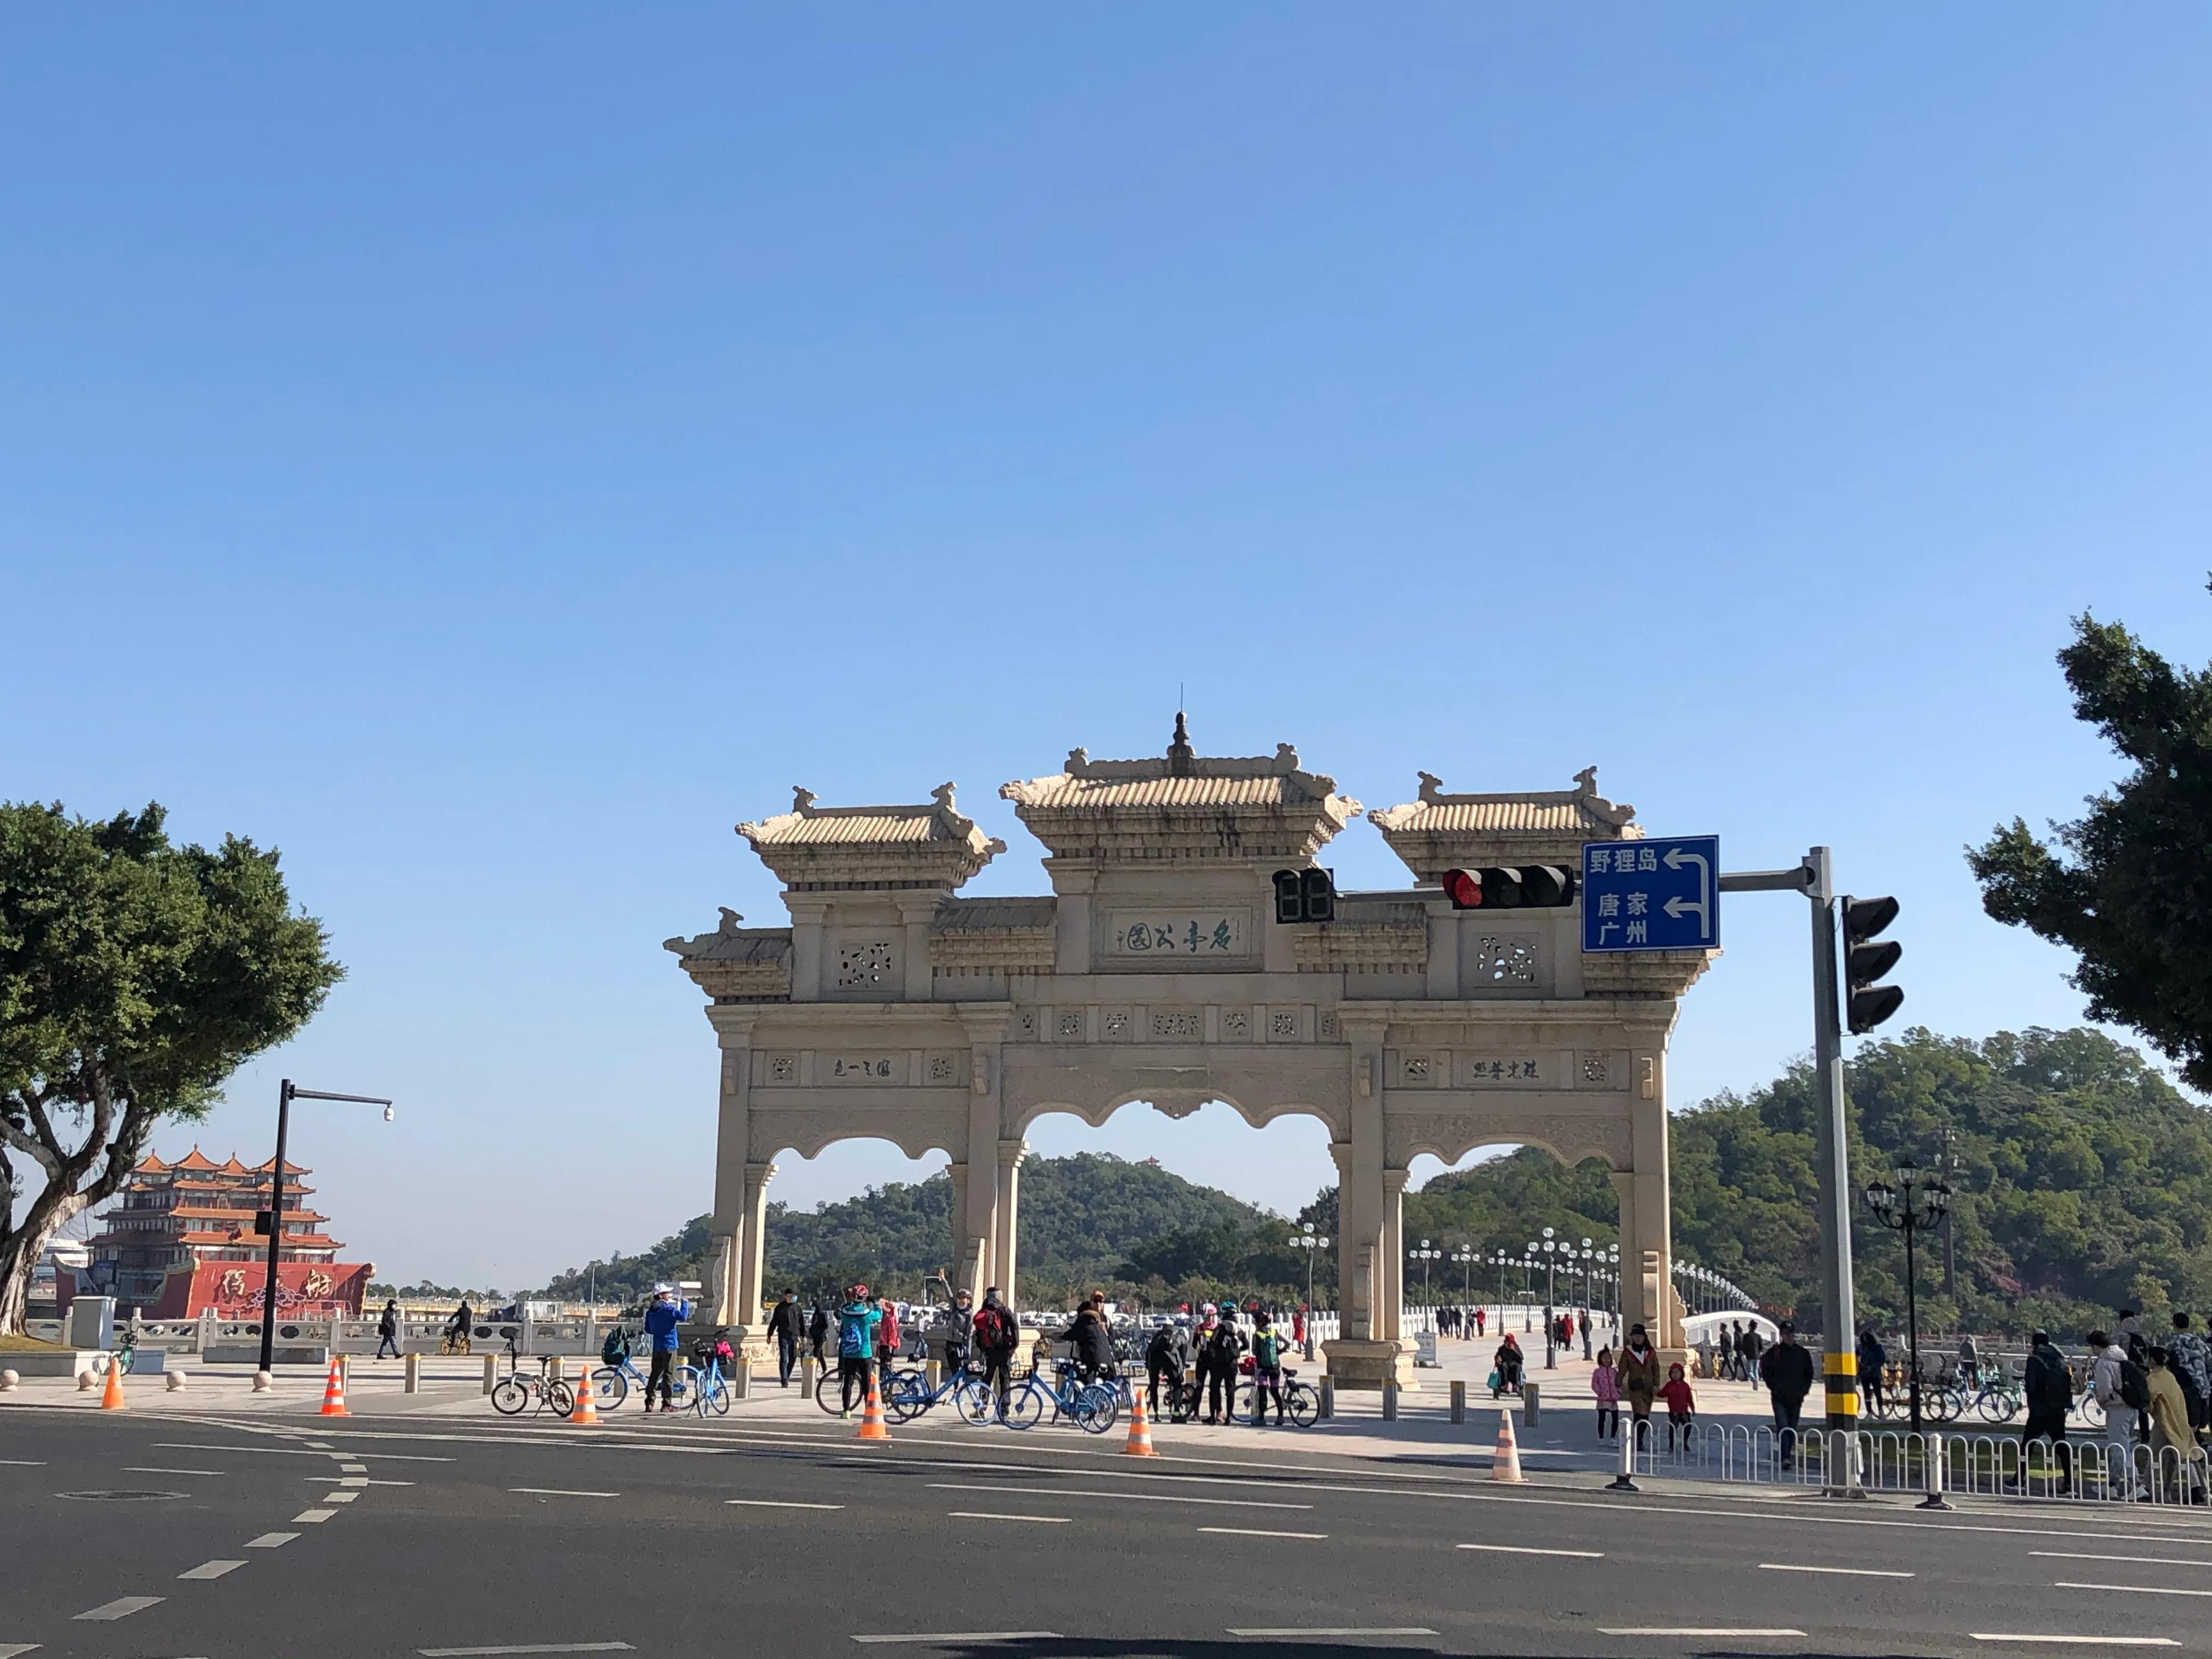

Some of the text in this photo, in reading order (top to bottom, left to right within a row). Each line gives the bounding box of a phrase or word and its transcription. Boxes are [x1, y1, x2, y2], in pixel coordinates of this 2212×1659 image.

[1589, 847, 1657, 873] 野狸岛
[1598, 892, 1648, 917] 唐家
[1599, 921, 1646, 945] 广州
